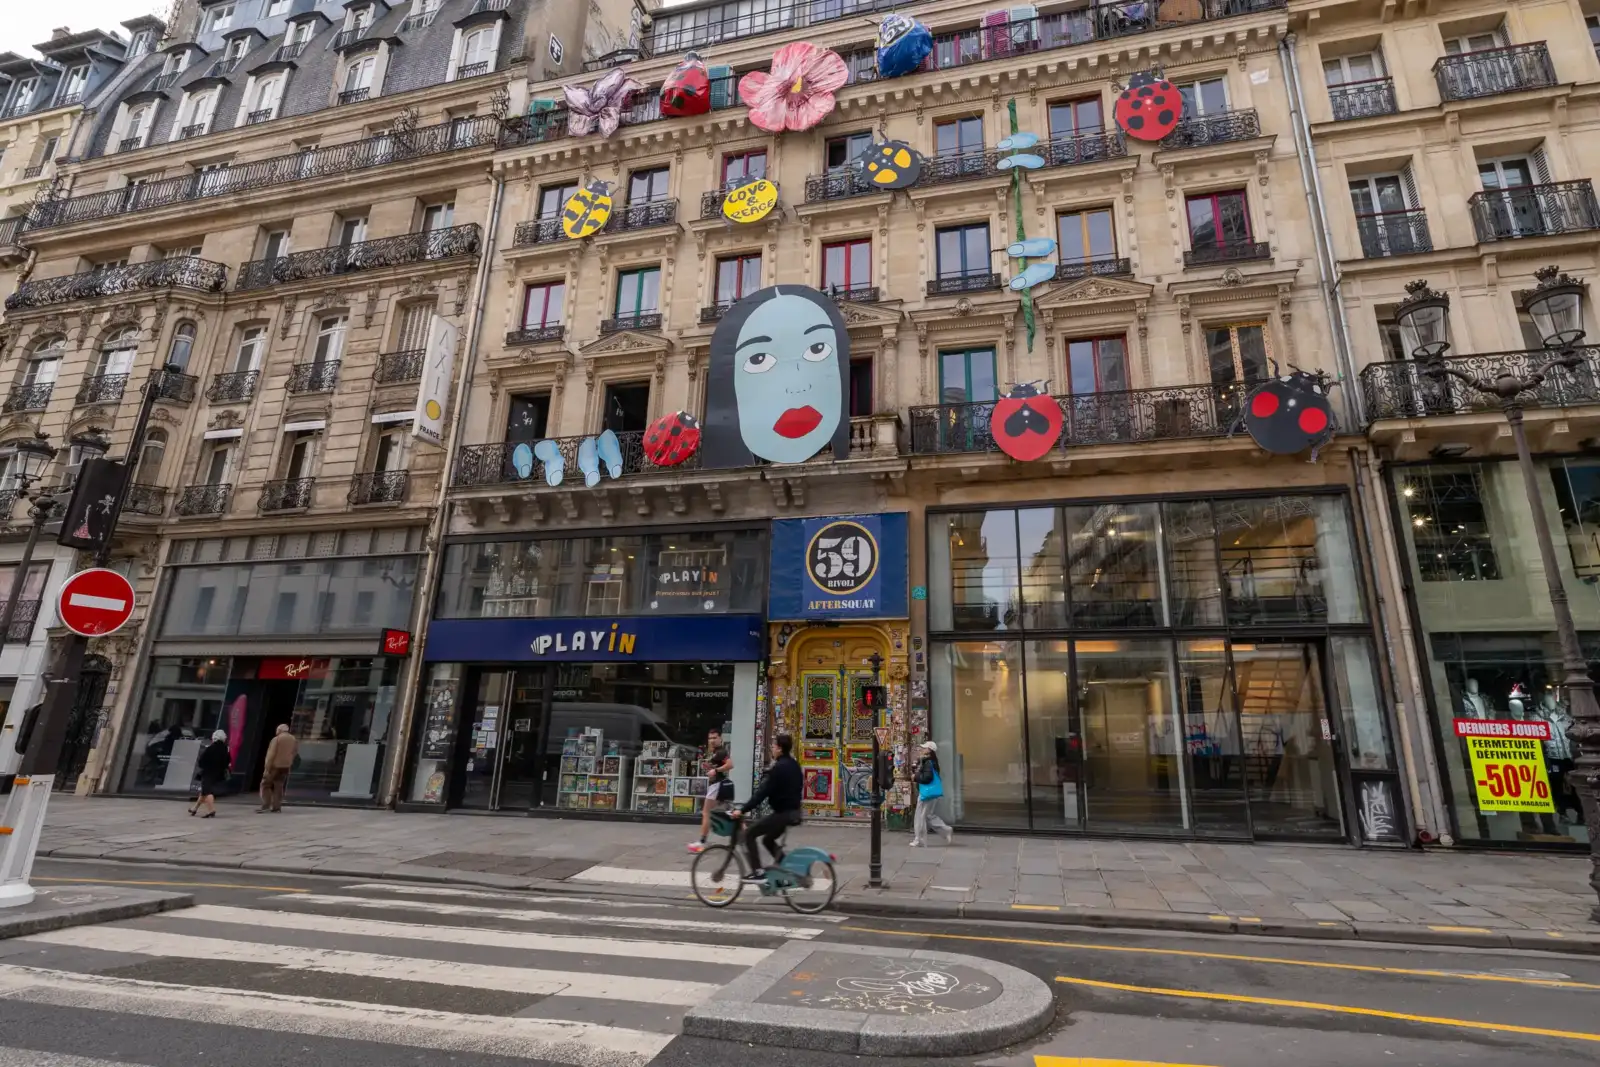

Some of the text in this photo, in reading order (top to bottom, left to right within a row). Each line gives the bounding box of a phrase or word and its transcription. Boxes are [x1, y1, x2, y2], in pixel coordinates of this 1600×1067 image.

[728, 181, 767, 203] LOVE
[420, 425, 440, 439] FRANCE
[815, 535, 872, 578] 59
[827, 580, 855, 588] RIVOLI
[808, 599, 876, 610] AFTERSQUAT
[284, 659, 310, 677] Ray-Ban
[1458, 722, 1547, 737] DERNIERS JOURS
[1472, 739, 1537, 749] FERMETURE
[1476, 750, 1537, 760] DÉFINITIVE
[1477, 764, 1549, 799] -50%
